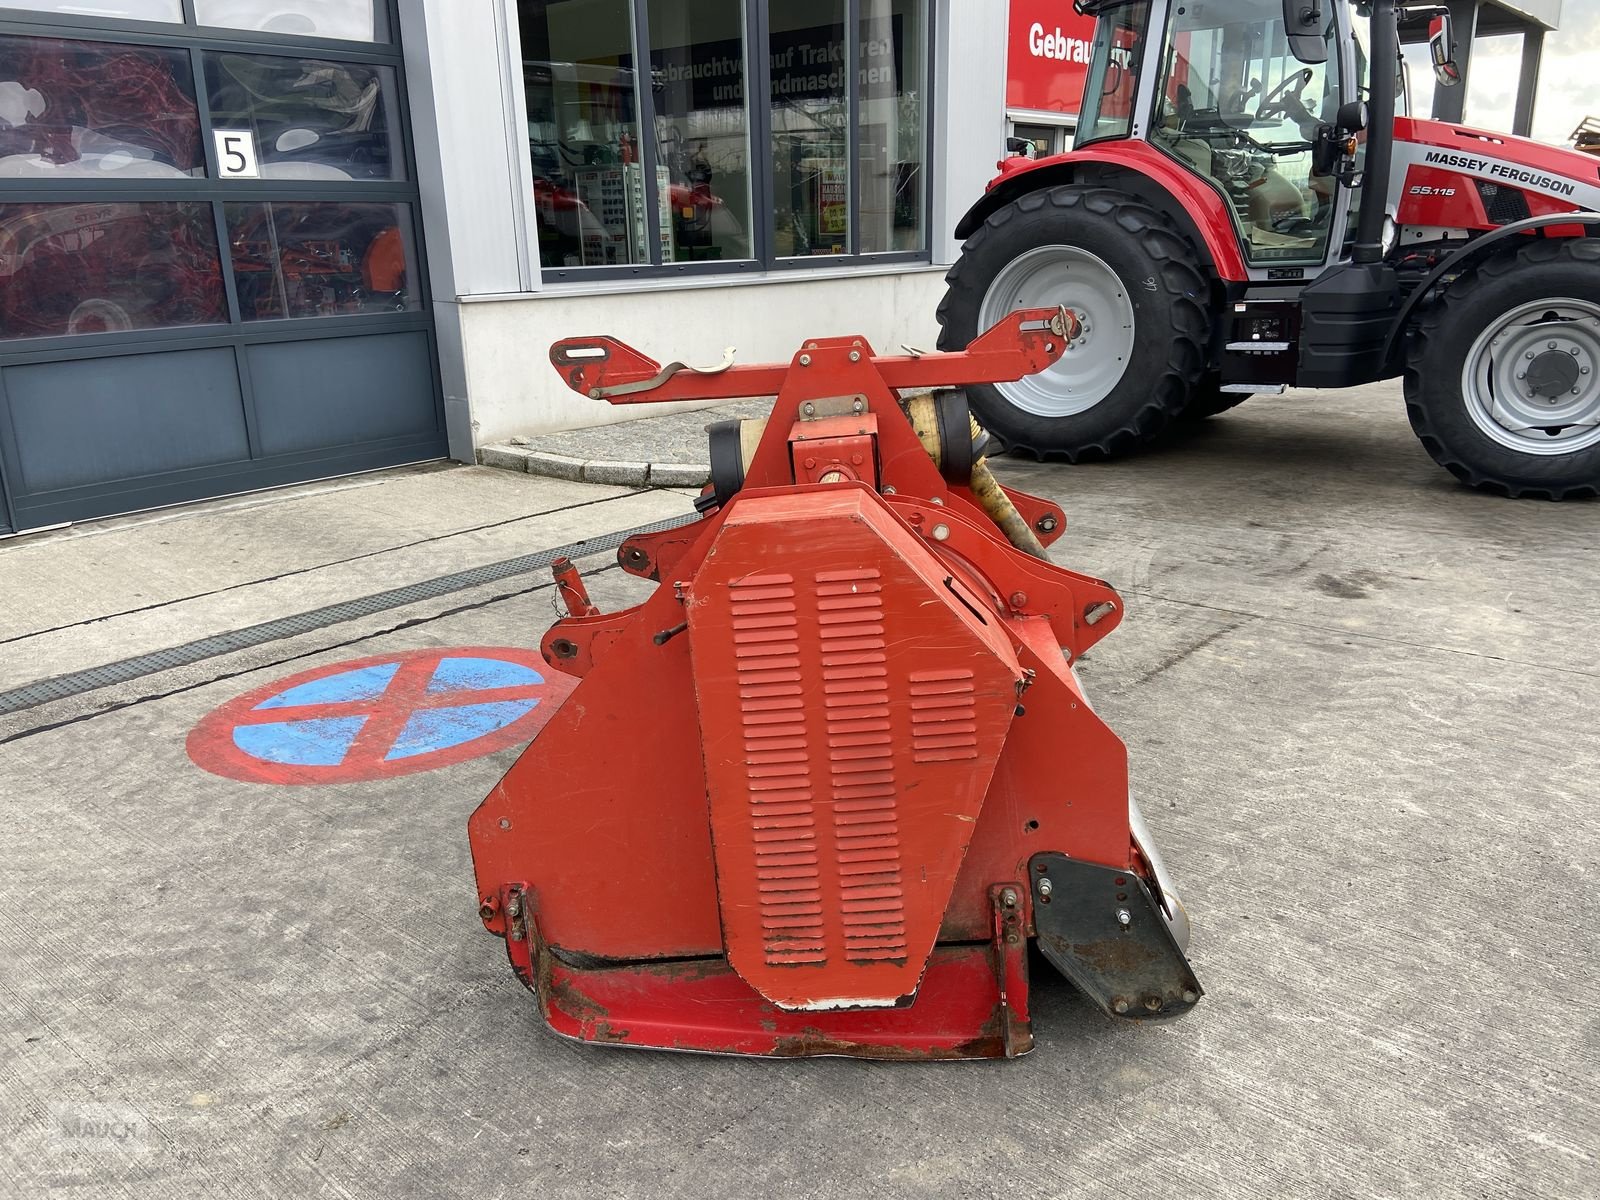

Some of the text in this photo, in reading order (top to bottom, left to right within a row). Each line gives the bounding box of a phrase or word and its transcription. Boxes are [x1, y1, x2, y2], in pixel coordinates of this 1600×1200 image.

[798, 38, 890, 66] Traktren
[713, 78, 744, 101] und
[225, 137, 246, 173] 5
[1425, 152, 1576, 196] MASSEY FERGUSON
[1409, 185, 1456, 197] 5S.115
